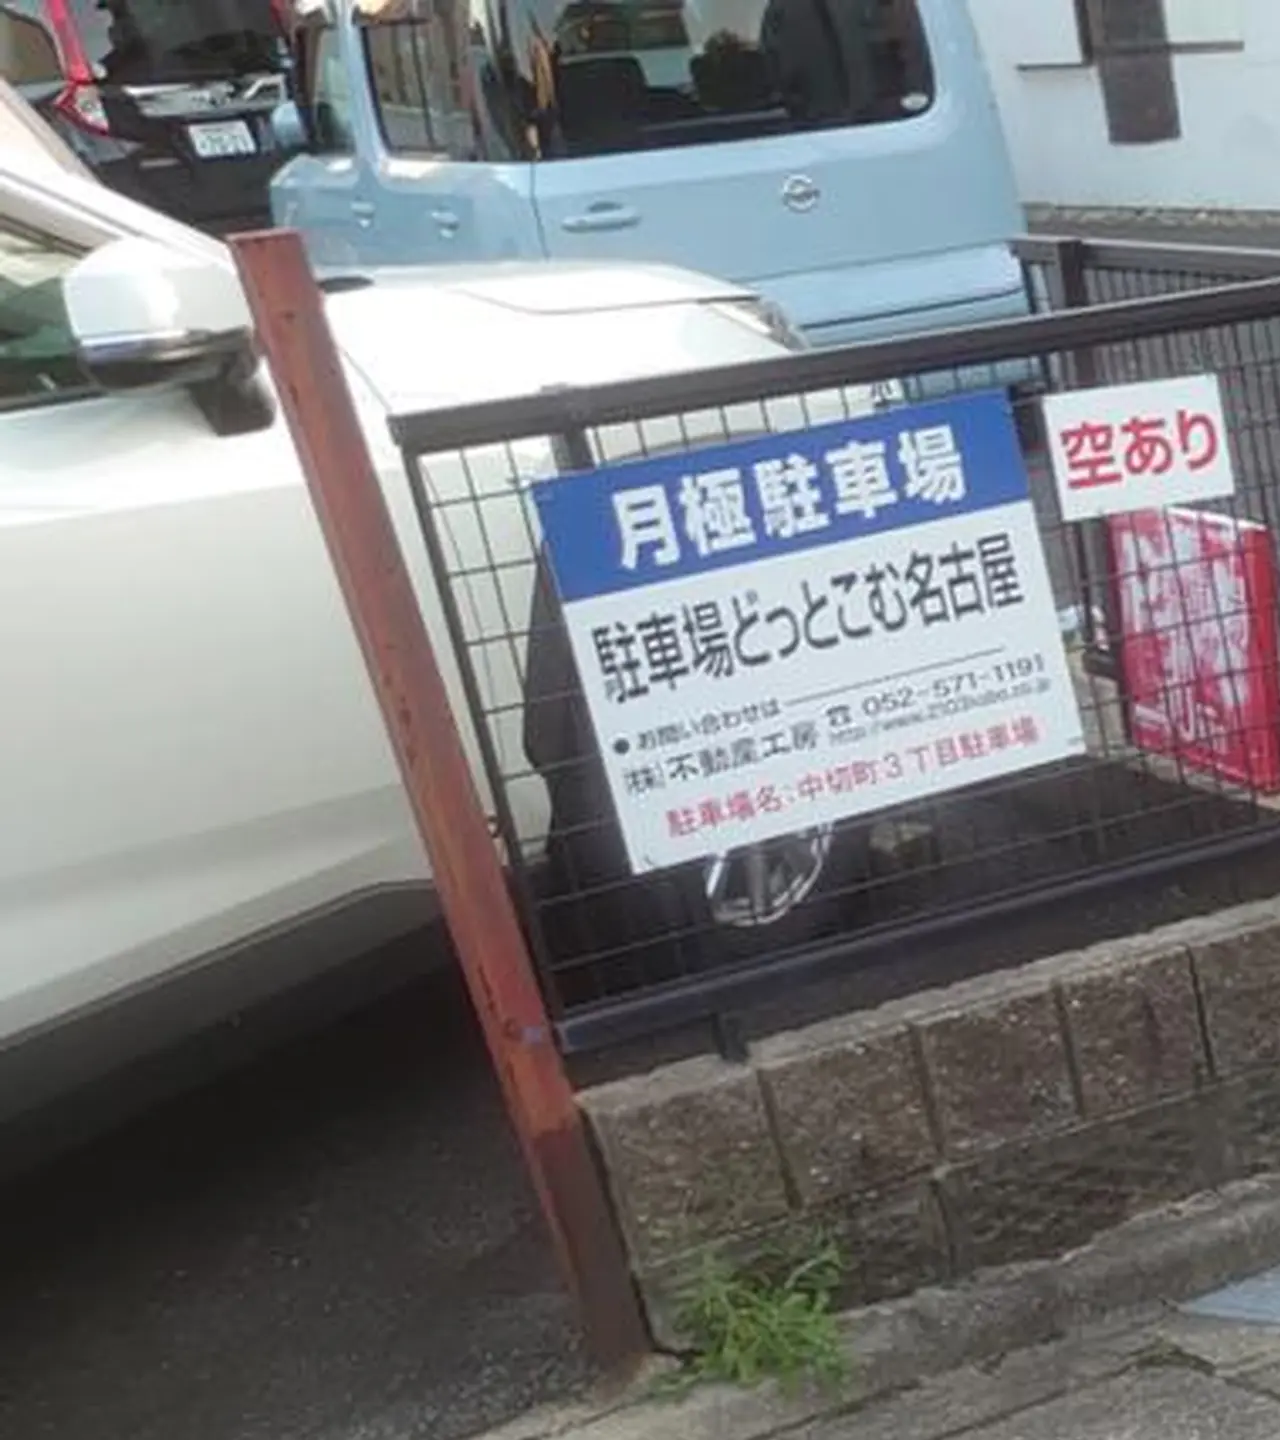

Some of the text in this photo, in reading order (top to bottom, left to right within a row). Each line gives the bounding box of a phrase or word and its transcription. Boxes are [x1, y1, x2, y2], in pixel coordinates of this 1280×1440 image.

[611, 424, 967, 570] 月極駐車場
[1059, 409, 1218, 490] 空あり
[593, 532, 1025, 704] 駐車場どっとこむ名古屋
